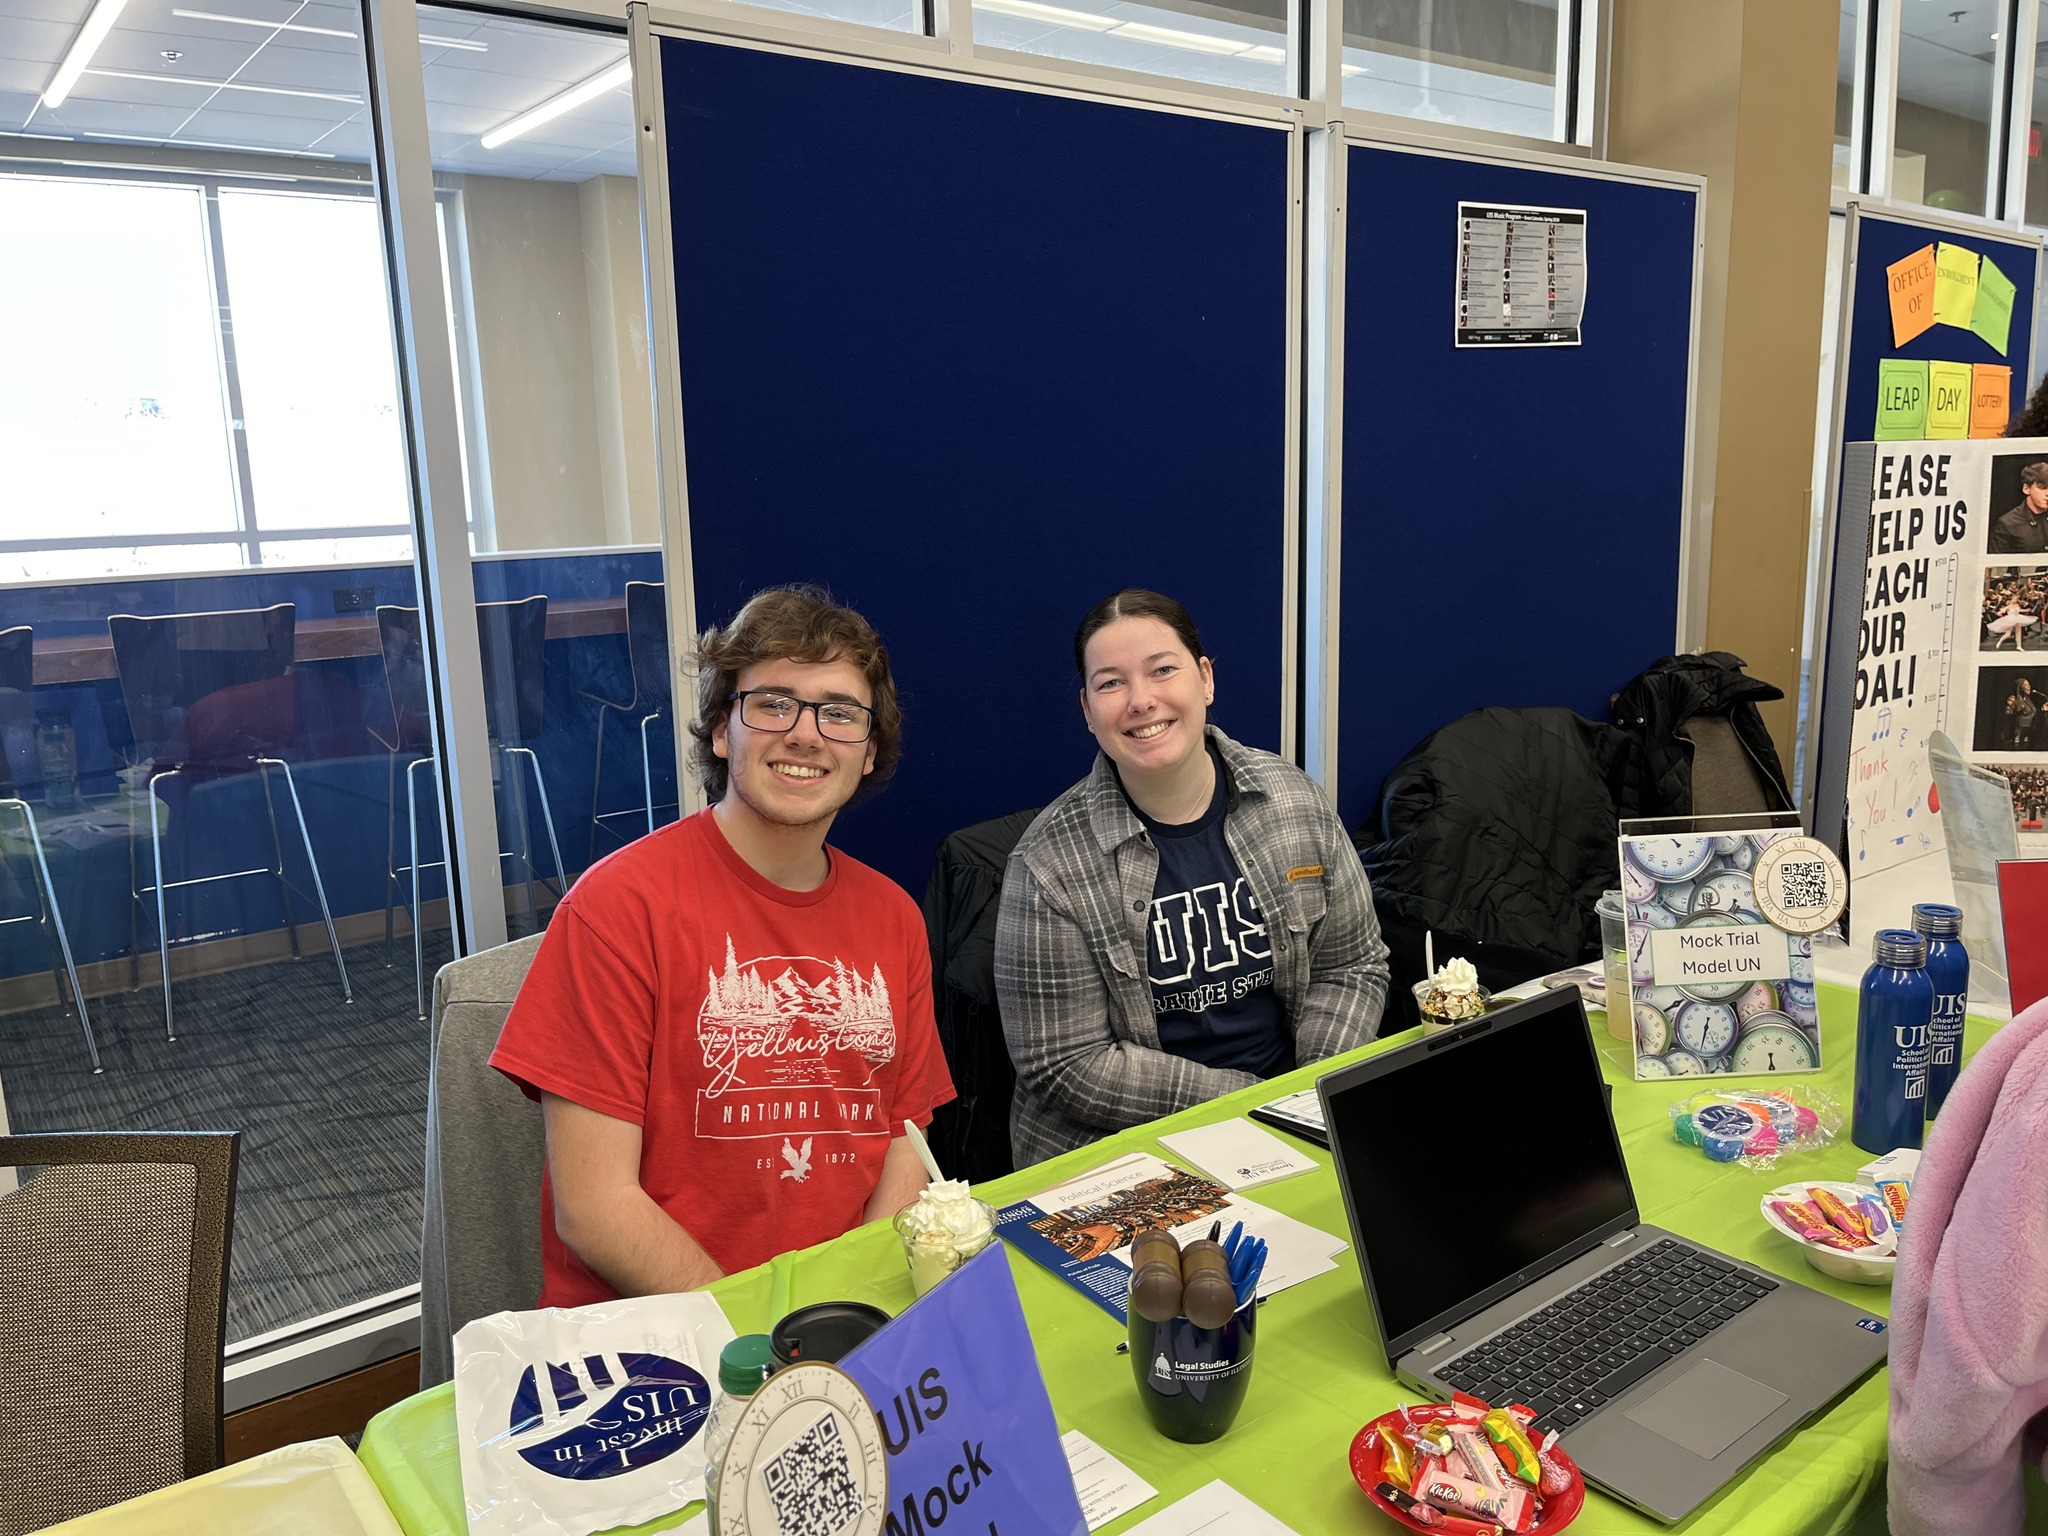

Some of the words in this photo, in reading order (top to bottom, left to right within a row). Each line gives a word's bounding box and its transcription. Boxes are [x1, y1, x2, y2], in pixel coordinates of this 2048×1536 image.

[1894, 260, 1932, 293] OFFICE
[1908, 294, 1923, 314] OF
[1886, 386, 1920, 411] LEAP
[1936, 387, 1962, 411] DAY
[1871, 454, 1952, 501] EASE
[1934, 500, 1968, 546] US
[1866, 558, 1930, 611] ACH
[1850, 746, 1888, 784] Thank
[1150, 878, 1272, 985] UIS
[1680, 934, 1723, 949] Mock
[1726, 932, 1760, 946] Trial
[1683, 960, 1732, 974] Model
[1736, 958, 1760, 972] UN
[703, 1016, 893, 1099] Yellowstone
[1901, 1048, 1924, 1056] School
[723, 1100, 820, 1124] NATIONAL
[825, 1153, 855, 1163] 1872
[1270, 1163, 1294, 1171] Invest
[1059, 1184, 1102, 1202] Political
[1101, 1172, 1144, 1188] Science
[1175, 1361, 1198, 1371] Legal
[1200, 1359, 1229, 1370] Studies
[1175, 1373, 1220, 1381] UNIVERSITY
[623, 1386, 700, 1422] UIS
[780, 1380, 805, 1404] XII
[751, 1414, 771, 1435] XI
[876, 1368, 948, 1456] UIS
[596, 1417, 682, 1453] invest
[554, 1444, 583, 1463] in
[865, 1441, 878, 1466] III
[885, 1440, 993, 1536] Mock
